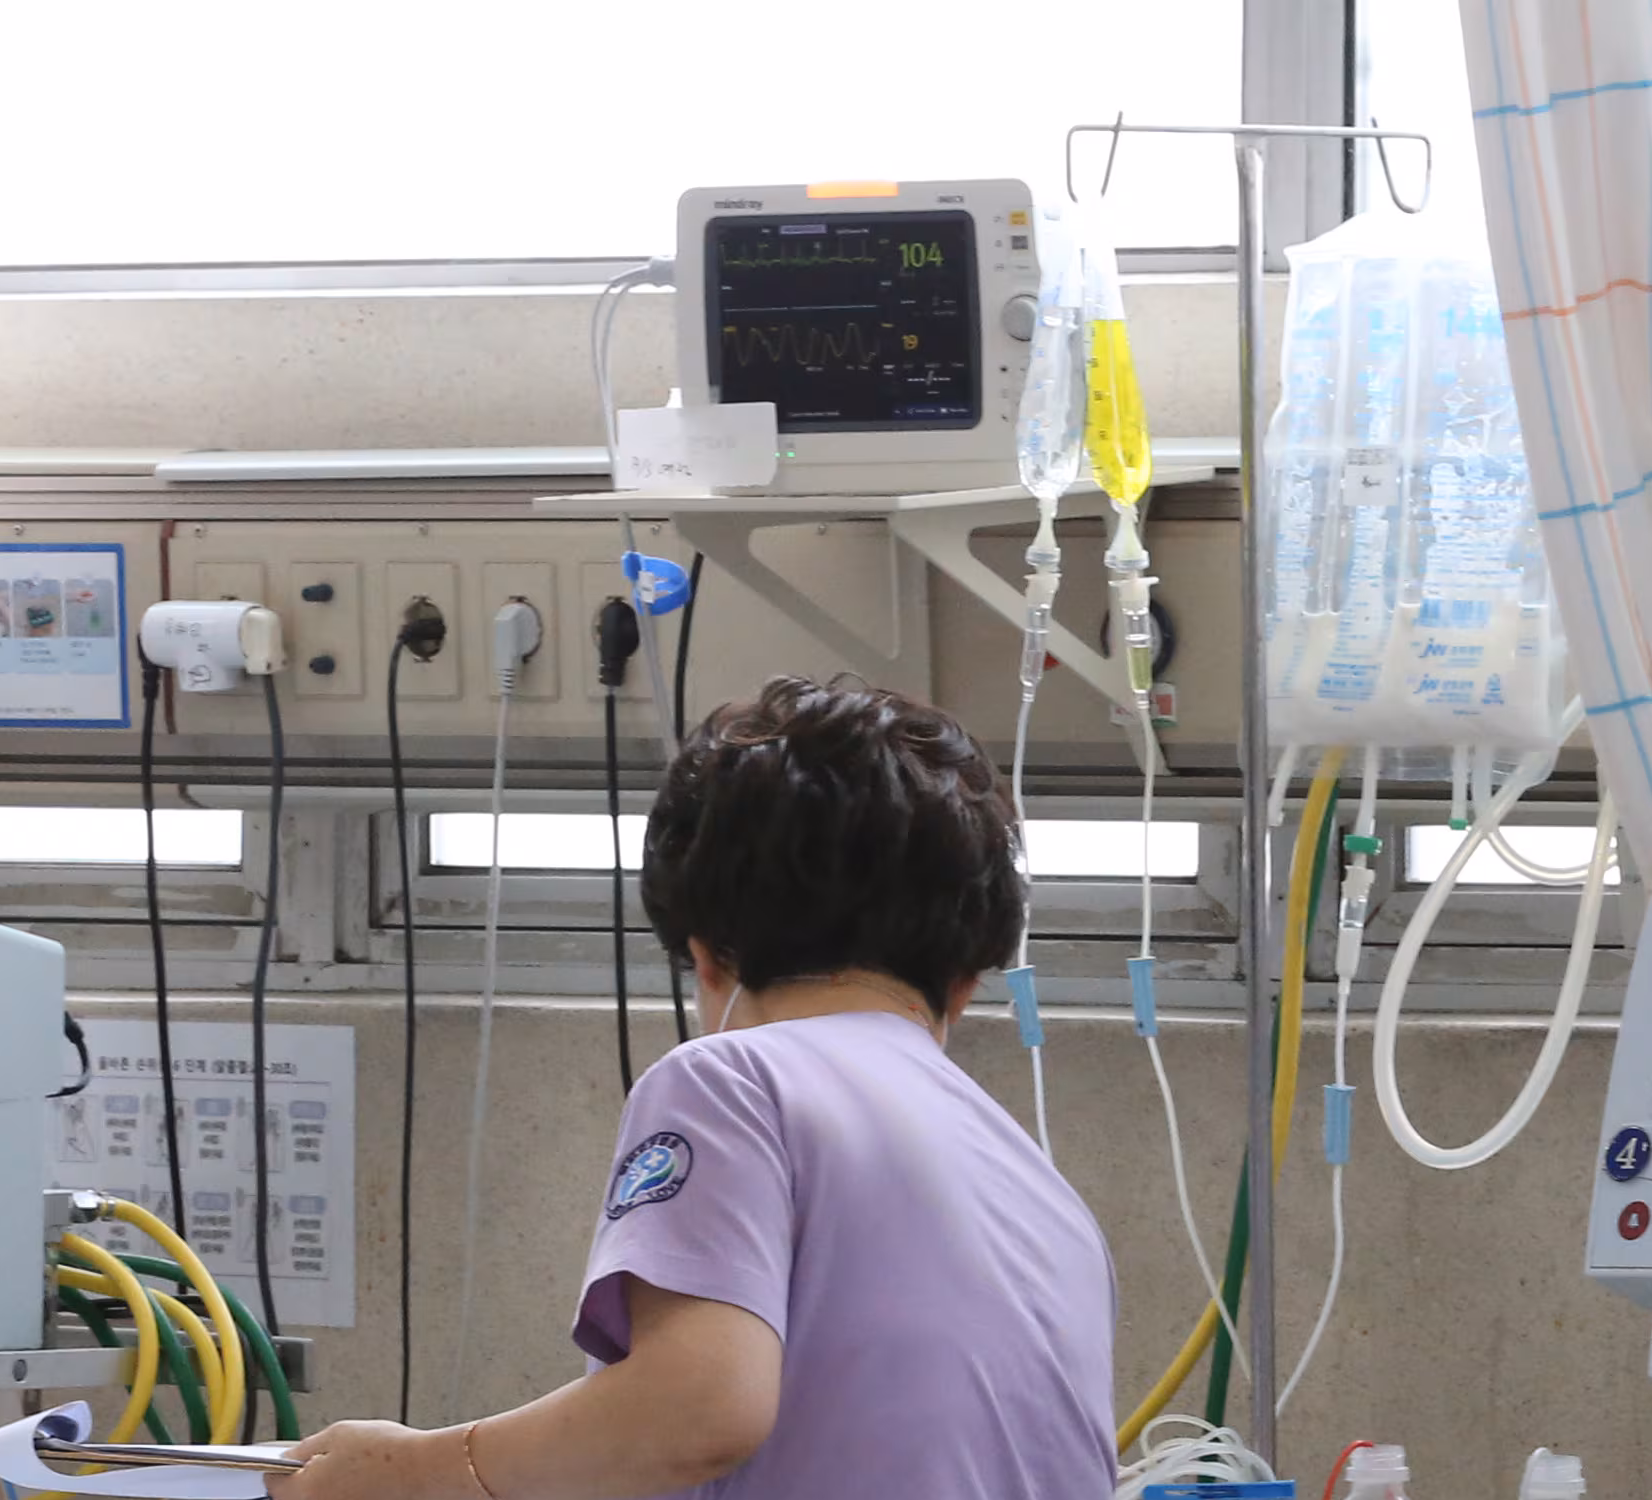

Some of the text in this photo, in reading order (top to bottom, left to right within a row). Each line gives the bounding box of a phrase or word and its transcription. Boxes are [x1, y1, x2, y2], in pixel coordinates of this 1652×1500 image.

[714, 199, 764, 211] mindray
[900, 242, 944, 268] 104
[1614, 1137, 1639, 1170] 4
